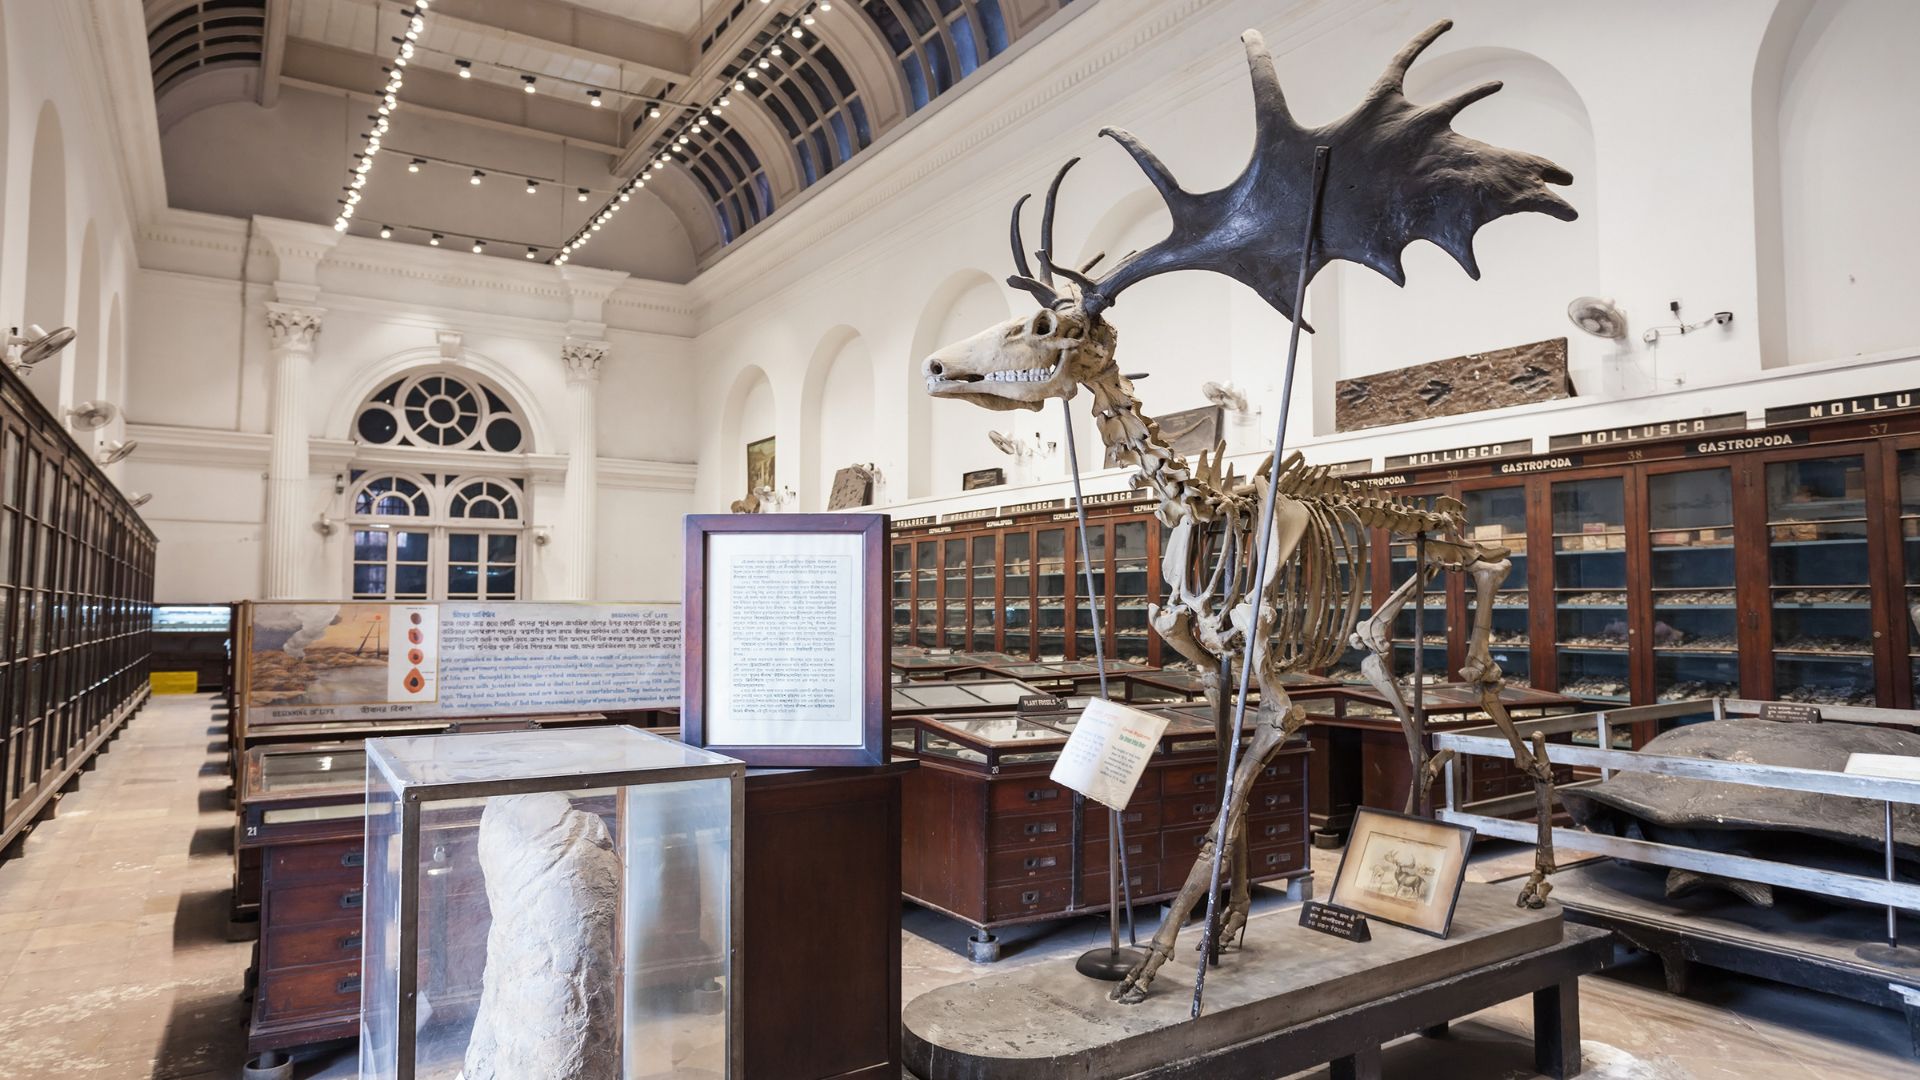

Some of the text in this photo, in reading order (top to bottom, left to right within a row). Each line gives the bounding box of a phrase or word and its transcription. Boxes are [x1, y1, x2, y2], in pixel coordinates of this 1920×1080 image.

[1810, 394, 1911, 418] MOLLU
[1582, 420, 1705, 445] MOLLUSCA
[1870, 423, 1888, 436] 37
[1698, 434, 1792, 452] GASTROPODA
[1409, 445, 1502, 466] MOLLUSCA
[1628, 450, 1643, 460] 38
[1501, 458, 1572, 473] GASTROPODA
[1448, 470, 1458, 480] 39
[1352, 476, 1406, 489] GTROPODA
[1082, 492, 1132, 505] MOLLUSCA
[1011, 502, 1053, 513] MOLLUSCA
[247, 827, 257, 837] 21
[1330, 926, 1351, 936] TOUCH
